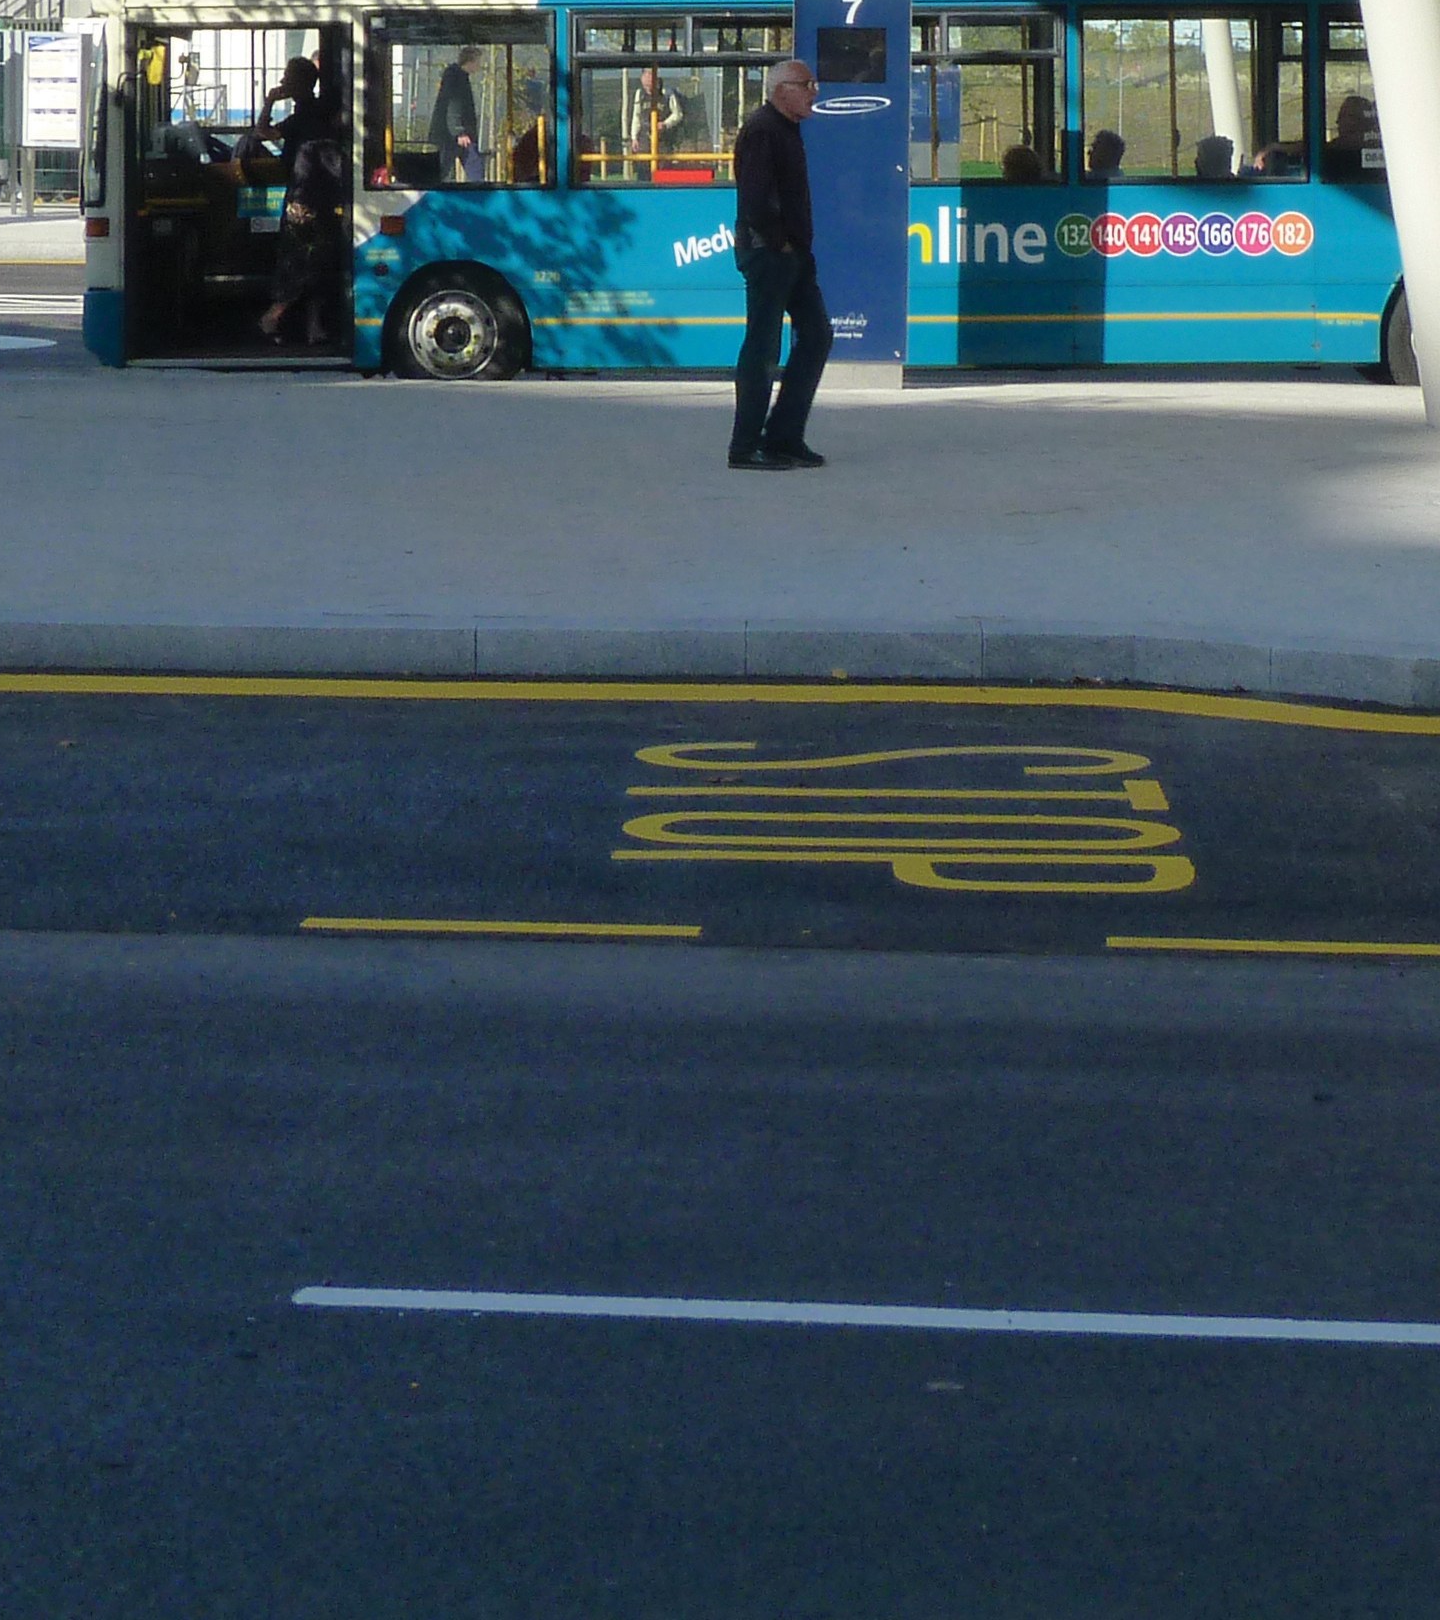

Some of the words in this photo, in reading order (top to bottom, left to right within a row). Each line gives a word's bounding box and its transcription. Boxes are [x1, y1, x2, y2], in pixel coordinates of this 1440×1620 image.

[907, 205, 1048, 264] nline
[1061, 223, 1089, 247] 132
[1095, 222, 1124, 246] 140
[1134, 222, 1160, 246] 141
[1166, 222, 1195, 246] 145
[1201, 222, 1231, 246] 166
[1239, 222, 1269, 246] 176
[1276, 222, 1306, 246] 182
[610, 740, 1196, 894] STOP
